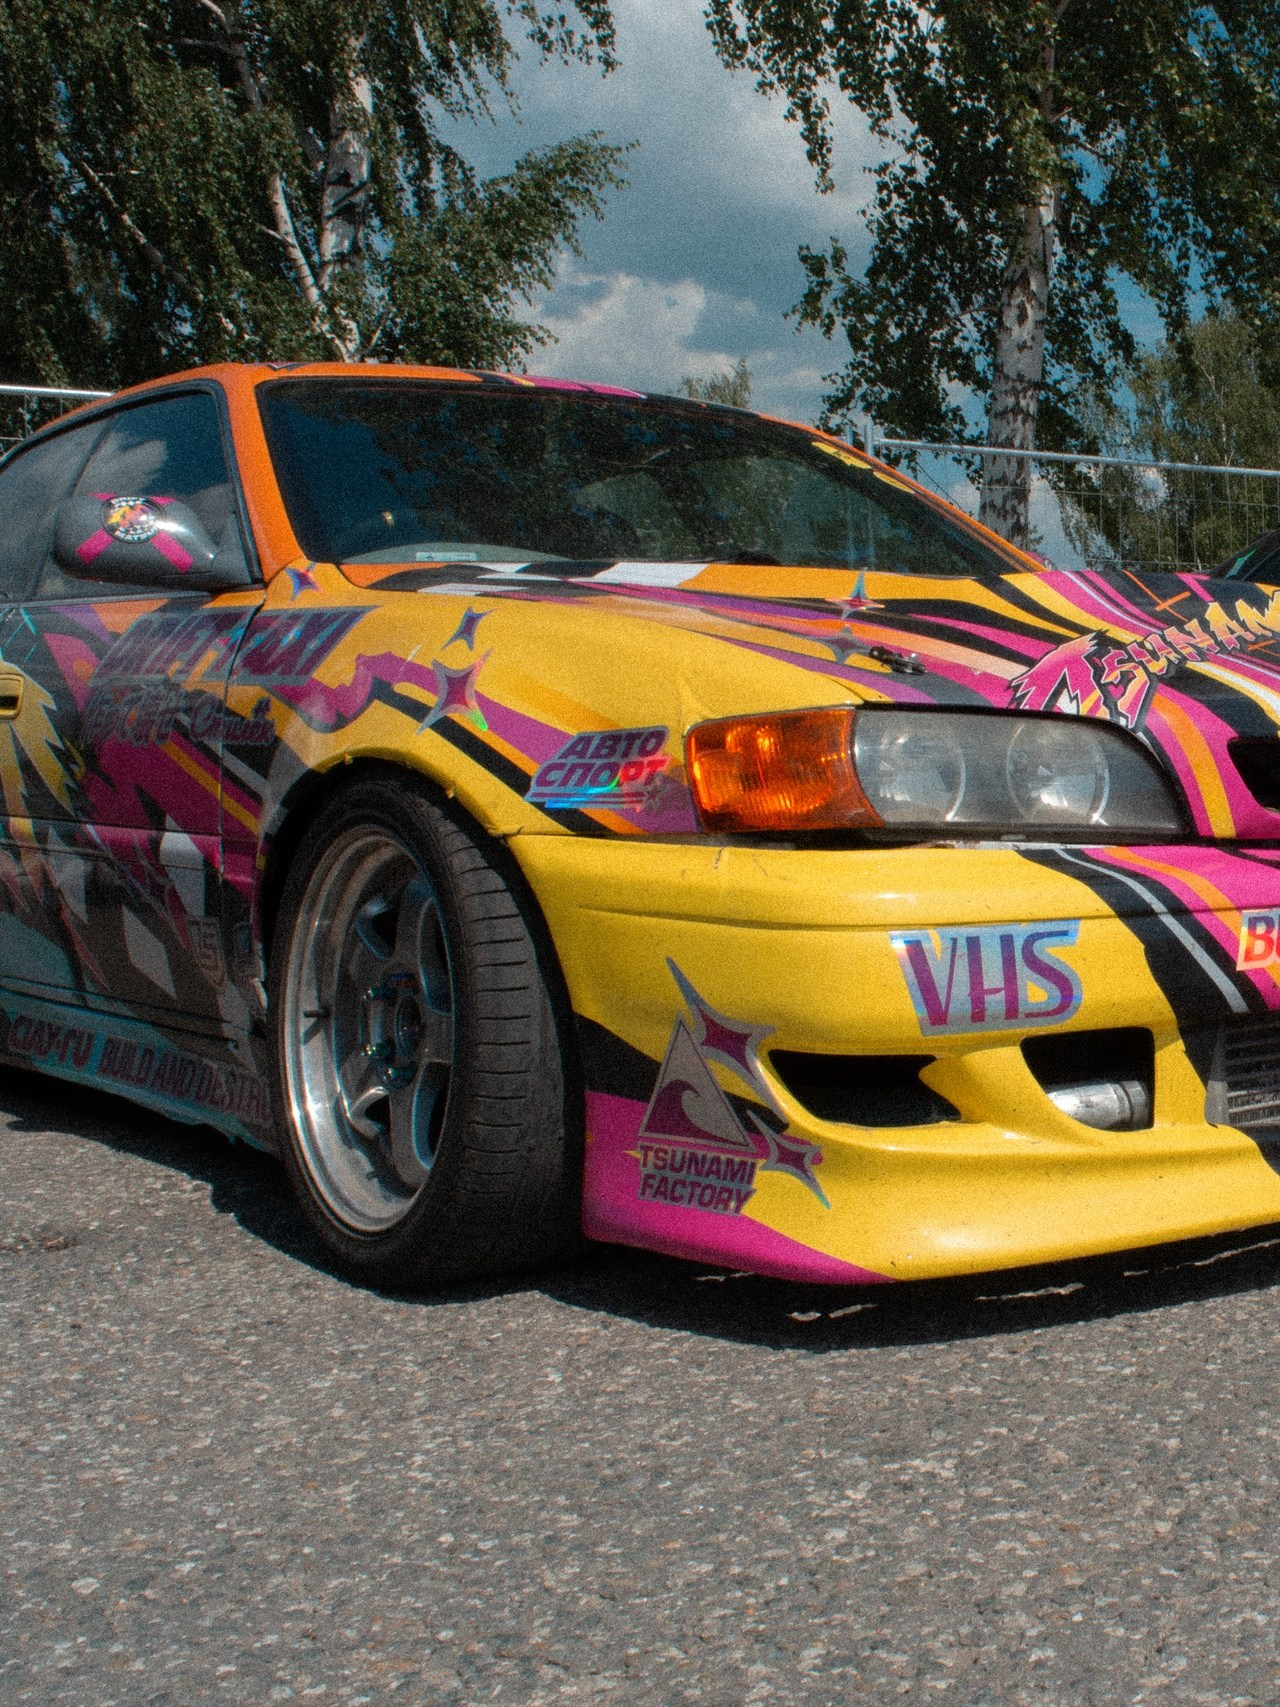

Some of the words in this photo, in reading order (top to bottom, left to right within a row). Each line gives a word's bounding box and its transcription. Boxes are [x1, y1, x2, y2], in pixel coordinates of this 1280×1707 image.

[559, 730, 665, 759] АВТО
[535, 759, 668, 787] СПОРТ
[903, 930, 1074, 1025] VHS
[640, 1145, 757, 1185] TSUNAMI
[640, 1173, 753, 1214] FACTORY
